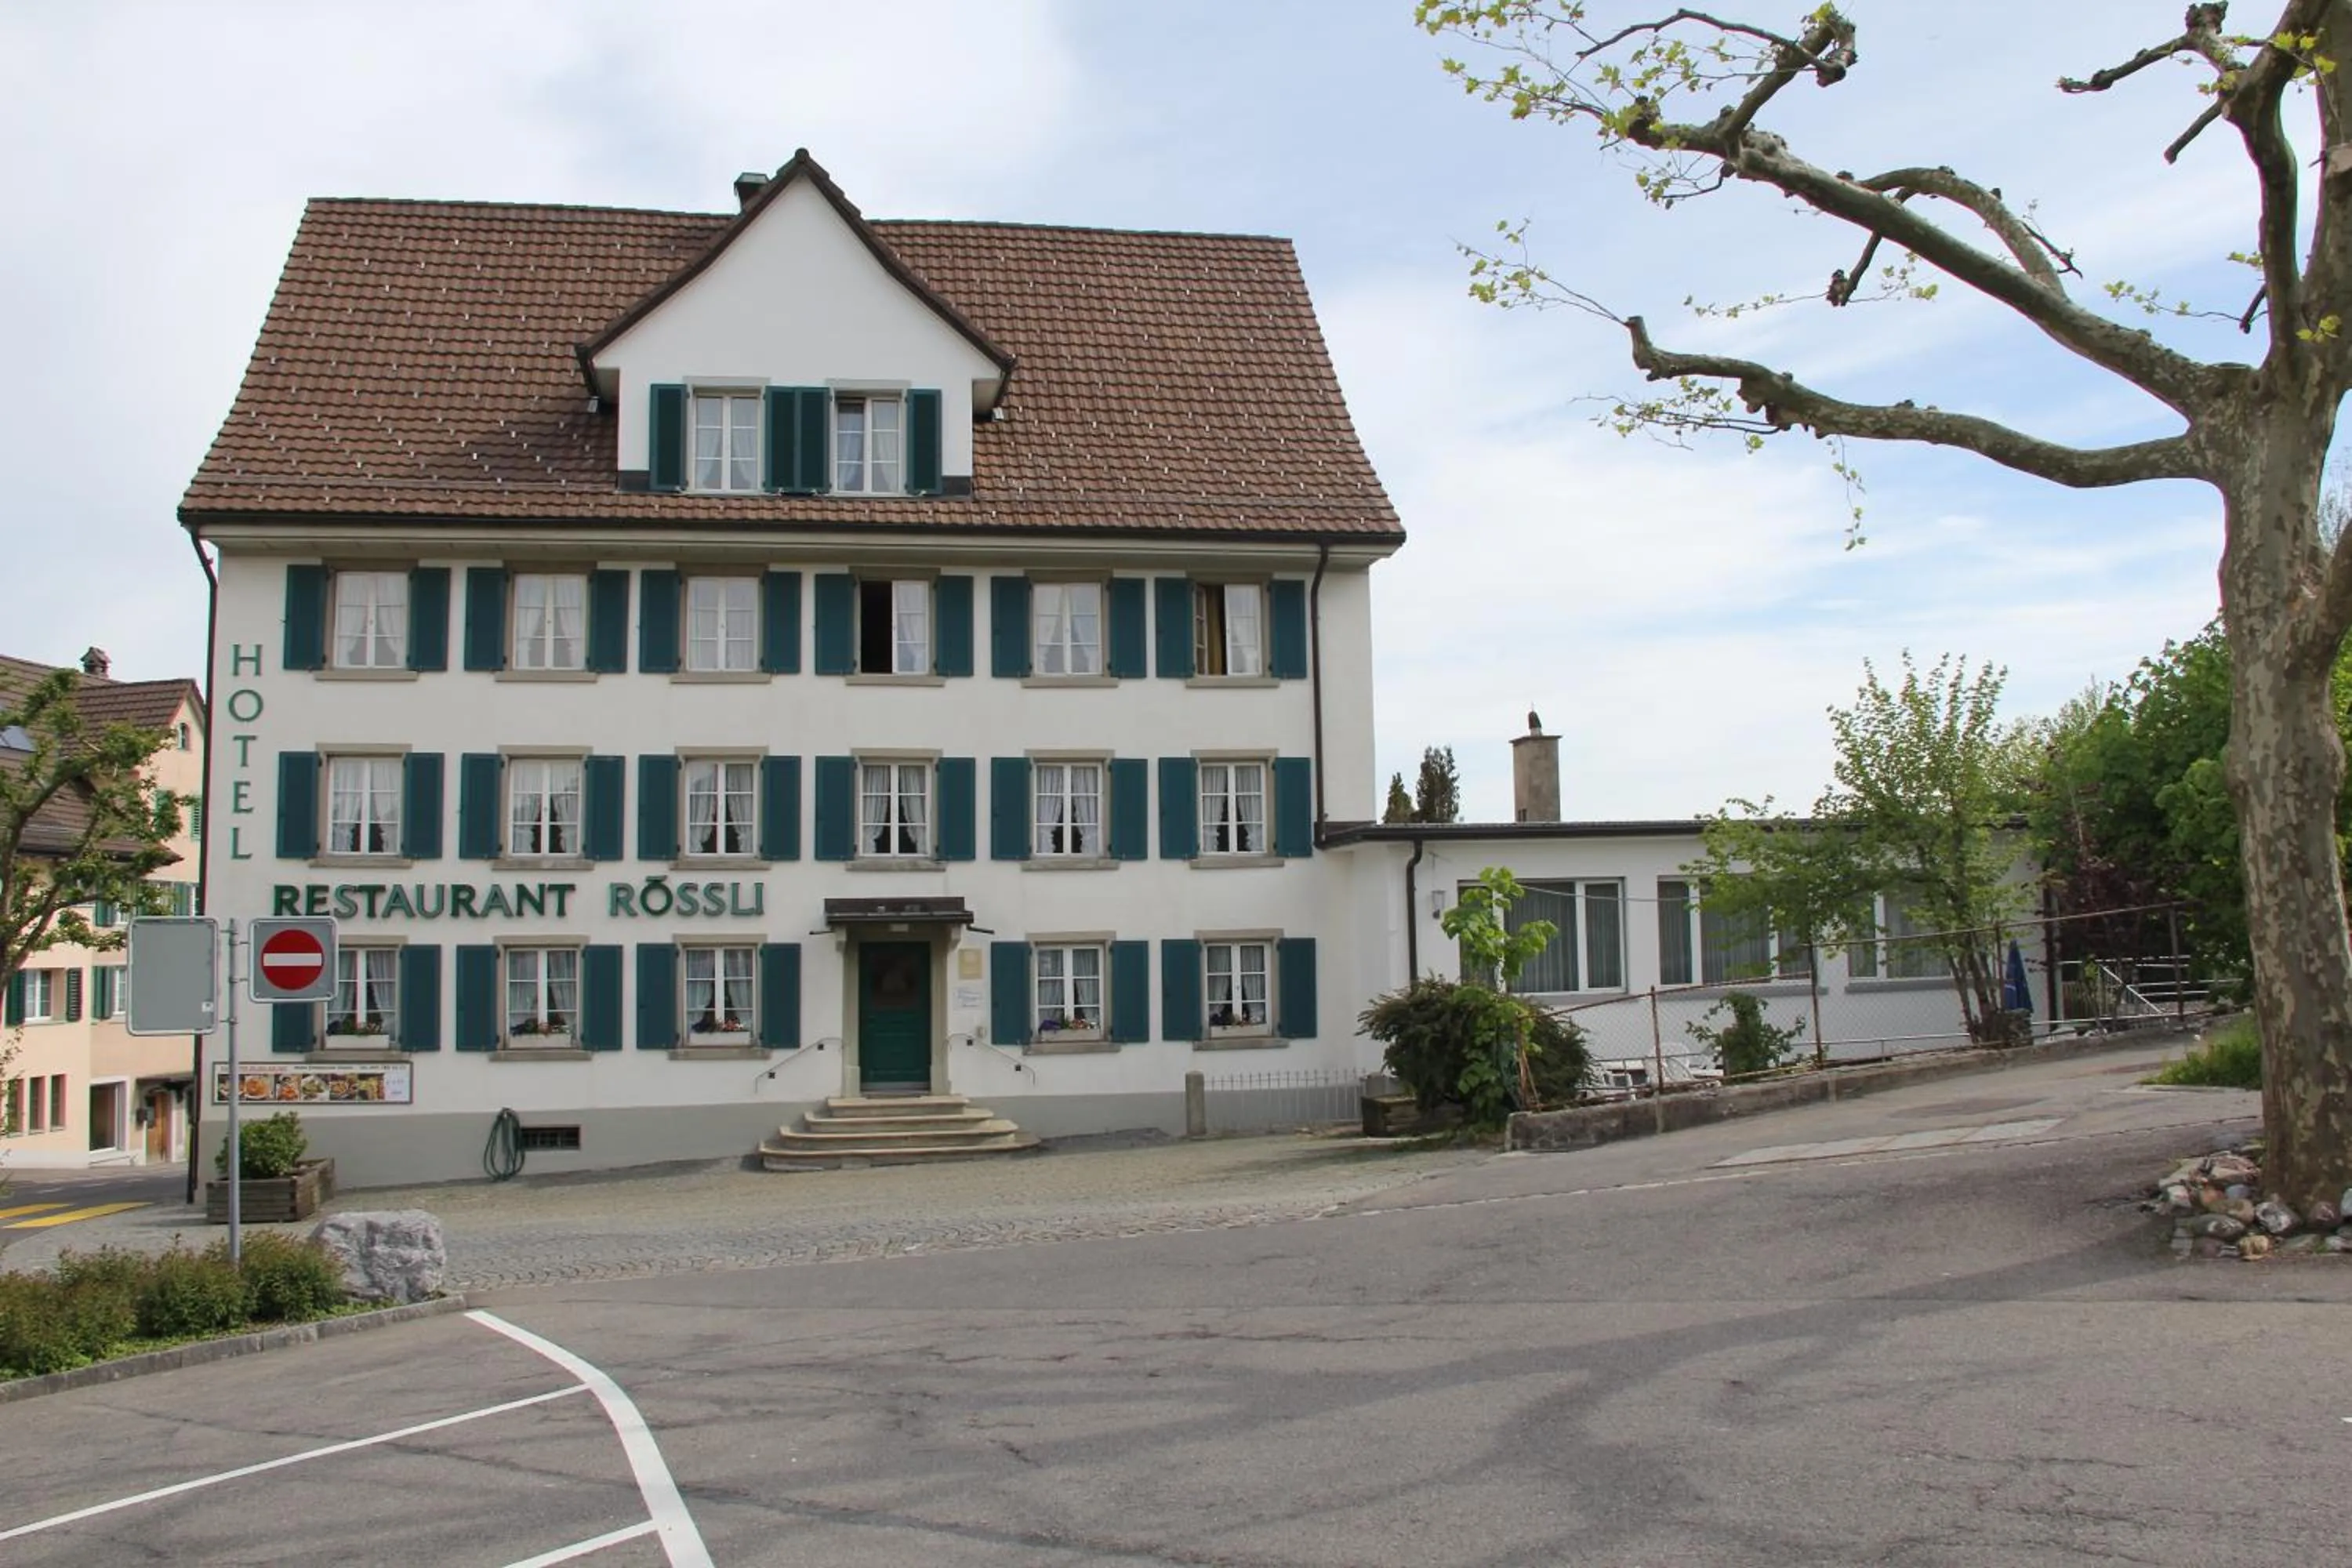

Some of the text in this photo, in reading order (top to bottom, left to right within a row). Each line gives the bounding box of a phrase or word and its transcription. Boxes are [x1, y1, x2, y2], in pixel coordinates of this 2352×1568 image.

[228, 644, 263, 860] HOTEL
[273, 875, 764, 919] RESTAURANT RÖSSLI
